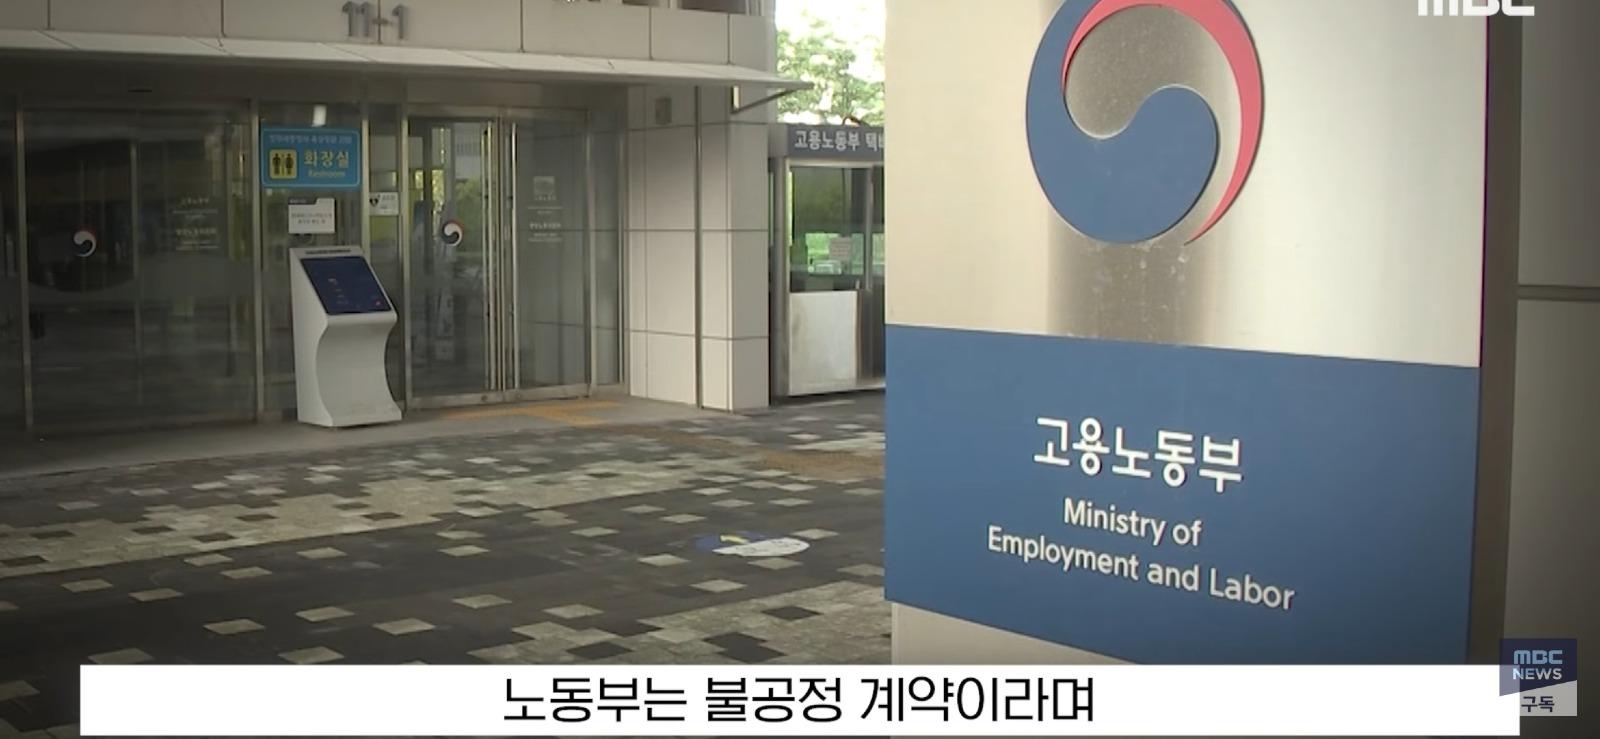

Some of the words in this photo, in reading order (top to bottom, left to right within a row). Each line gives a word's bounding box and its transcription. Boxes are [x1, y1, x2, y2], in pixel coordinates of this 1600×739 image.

[342, 1, 407, 40] 11-1
[303, 149, 349, 169] 화장실
[794, 130, 861, 152] 고용노동부
[1033, 416, 1243, 493] 고용노동부
[1063, 497, 1166, 546] Ministry
[1172, 518, 1203, 547] of
[987, 525, 1140, 581] Employment
[1147, 564, 1200, 592] and
[1209, 567, 1296, 610] Labor
